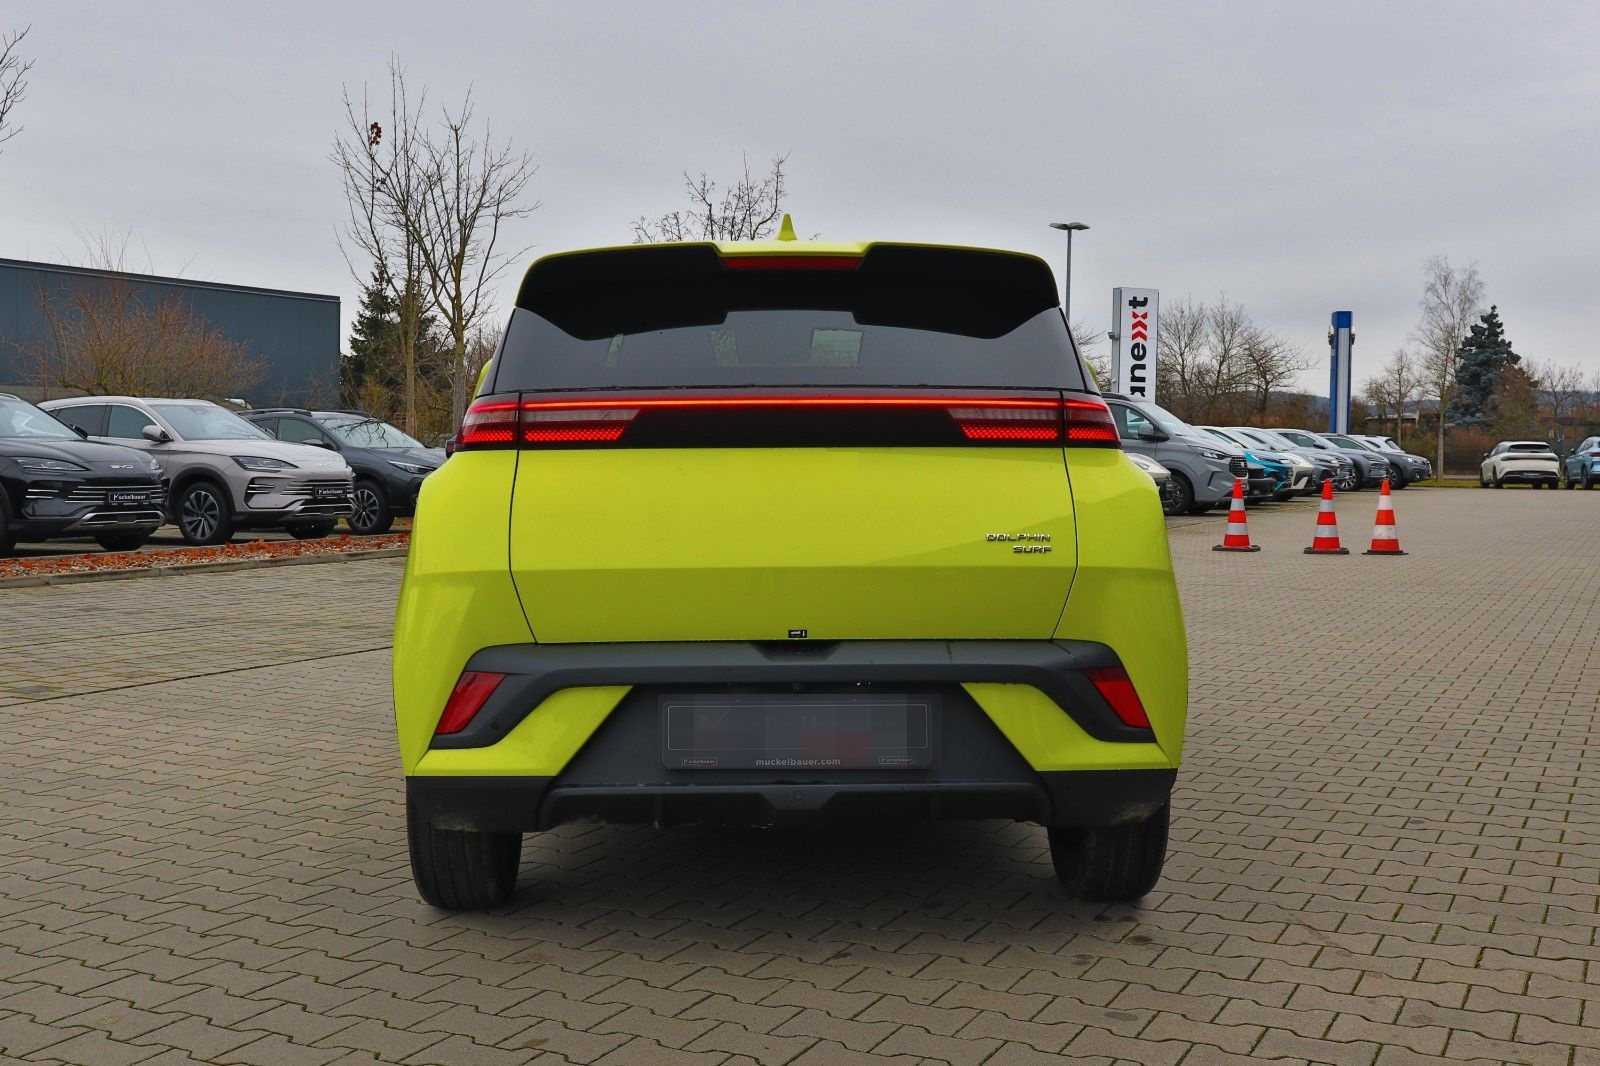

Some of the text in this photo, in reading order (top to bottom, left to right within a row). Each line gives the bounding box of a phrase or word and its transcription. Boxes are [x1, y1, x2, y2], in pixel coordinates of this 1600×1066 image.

[986, 533, 1051, 542] DOLPHIN
[1013, 545, 1052, 554] SURF
[755, 757, 841, 767] muckelbauer.com
